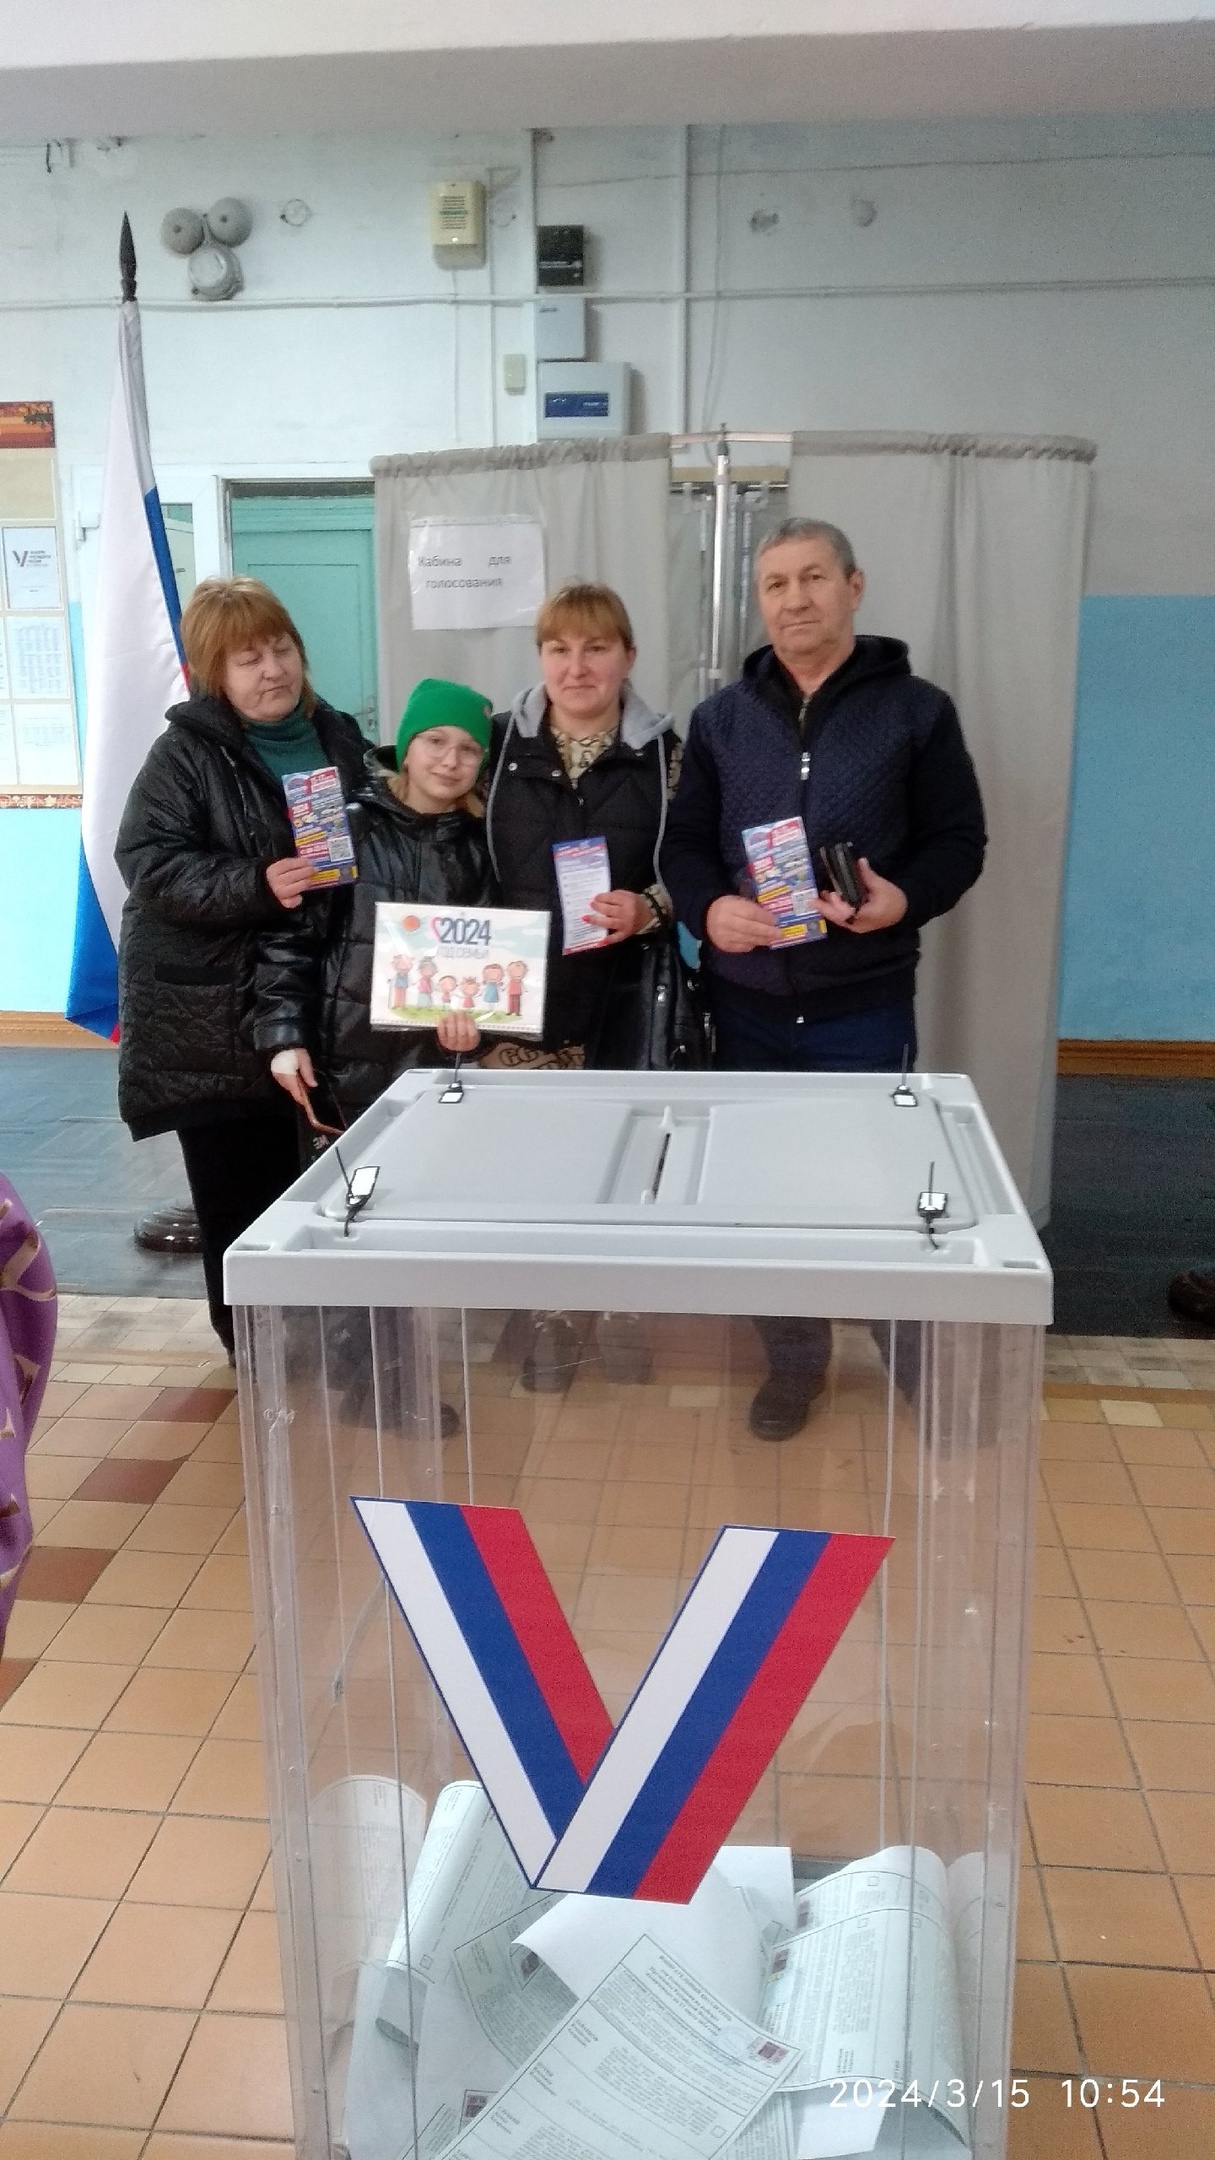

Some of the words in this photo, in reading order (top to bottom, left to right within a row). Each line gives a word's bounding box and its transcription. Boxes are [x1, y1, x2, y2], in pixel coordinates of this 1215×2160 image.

[419, 555, 462, 567] Кабина
[488, 556, 512, 568] для
[426, 578, 503, 589] голосования
[440, 917, 491, 946] 2024
